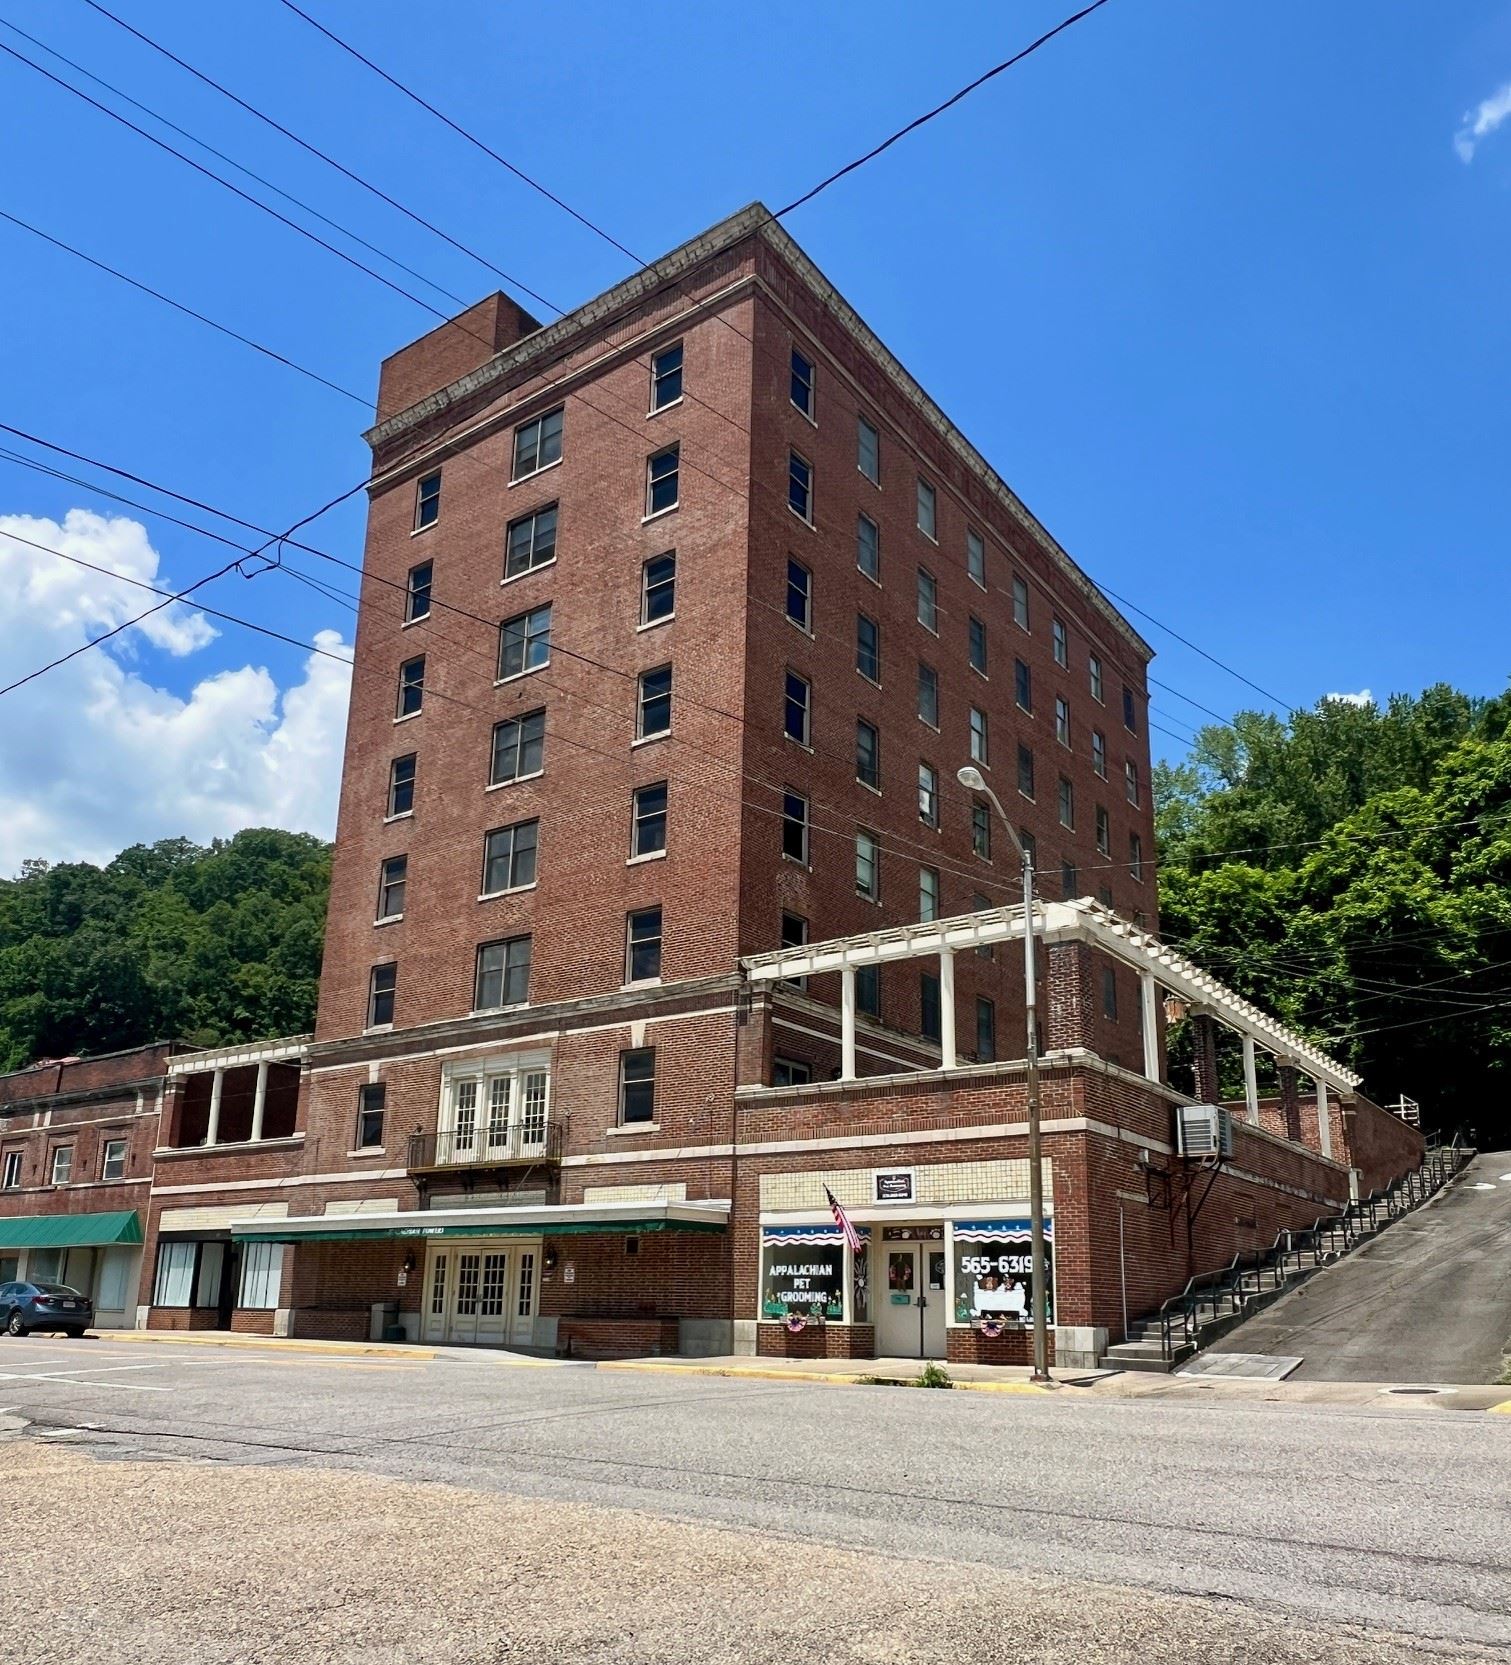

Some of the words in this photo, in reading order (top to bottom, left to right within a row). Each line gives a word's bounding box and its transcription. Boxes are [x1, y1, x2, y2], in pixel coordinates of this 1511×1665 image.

[769, 1264, 833, 1276] APPALACHIAN
[961, 1255, 1033, 1274] 565-6319
[793, 1277, 811, 1289] PET
[780, 1291, 827, 1303] GROOMING
